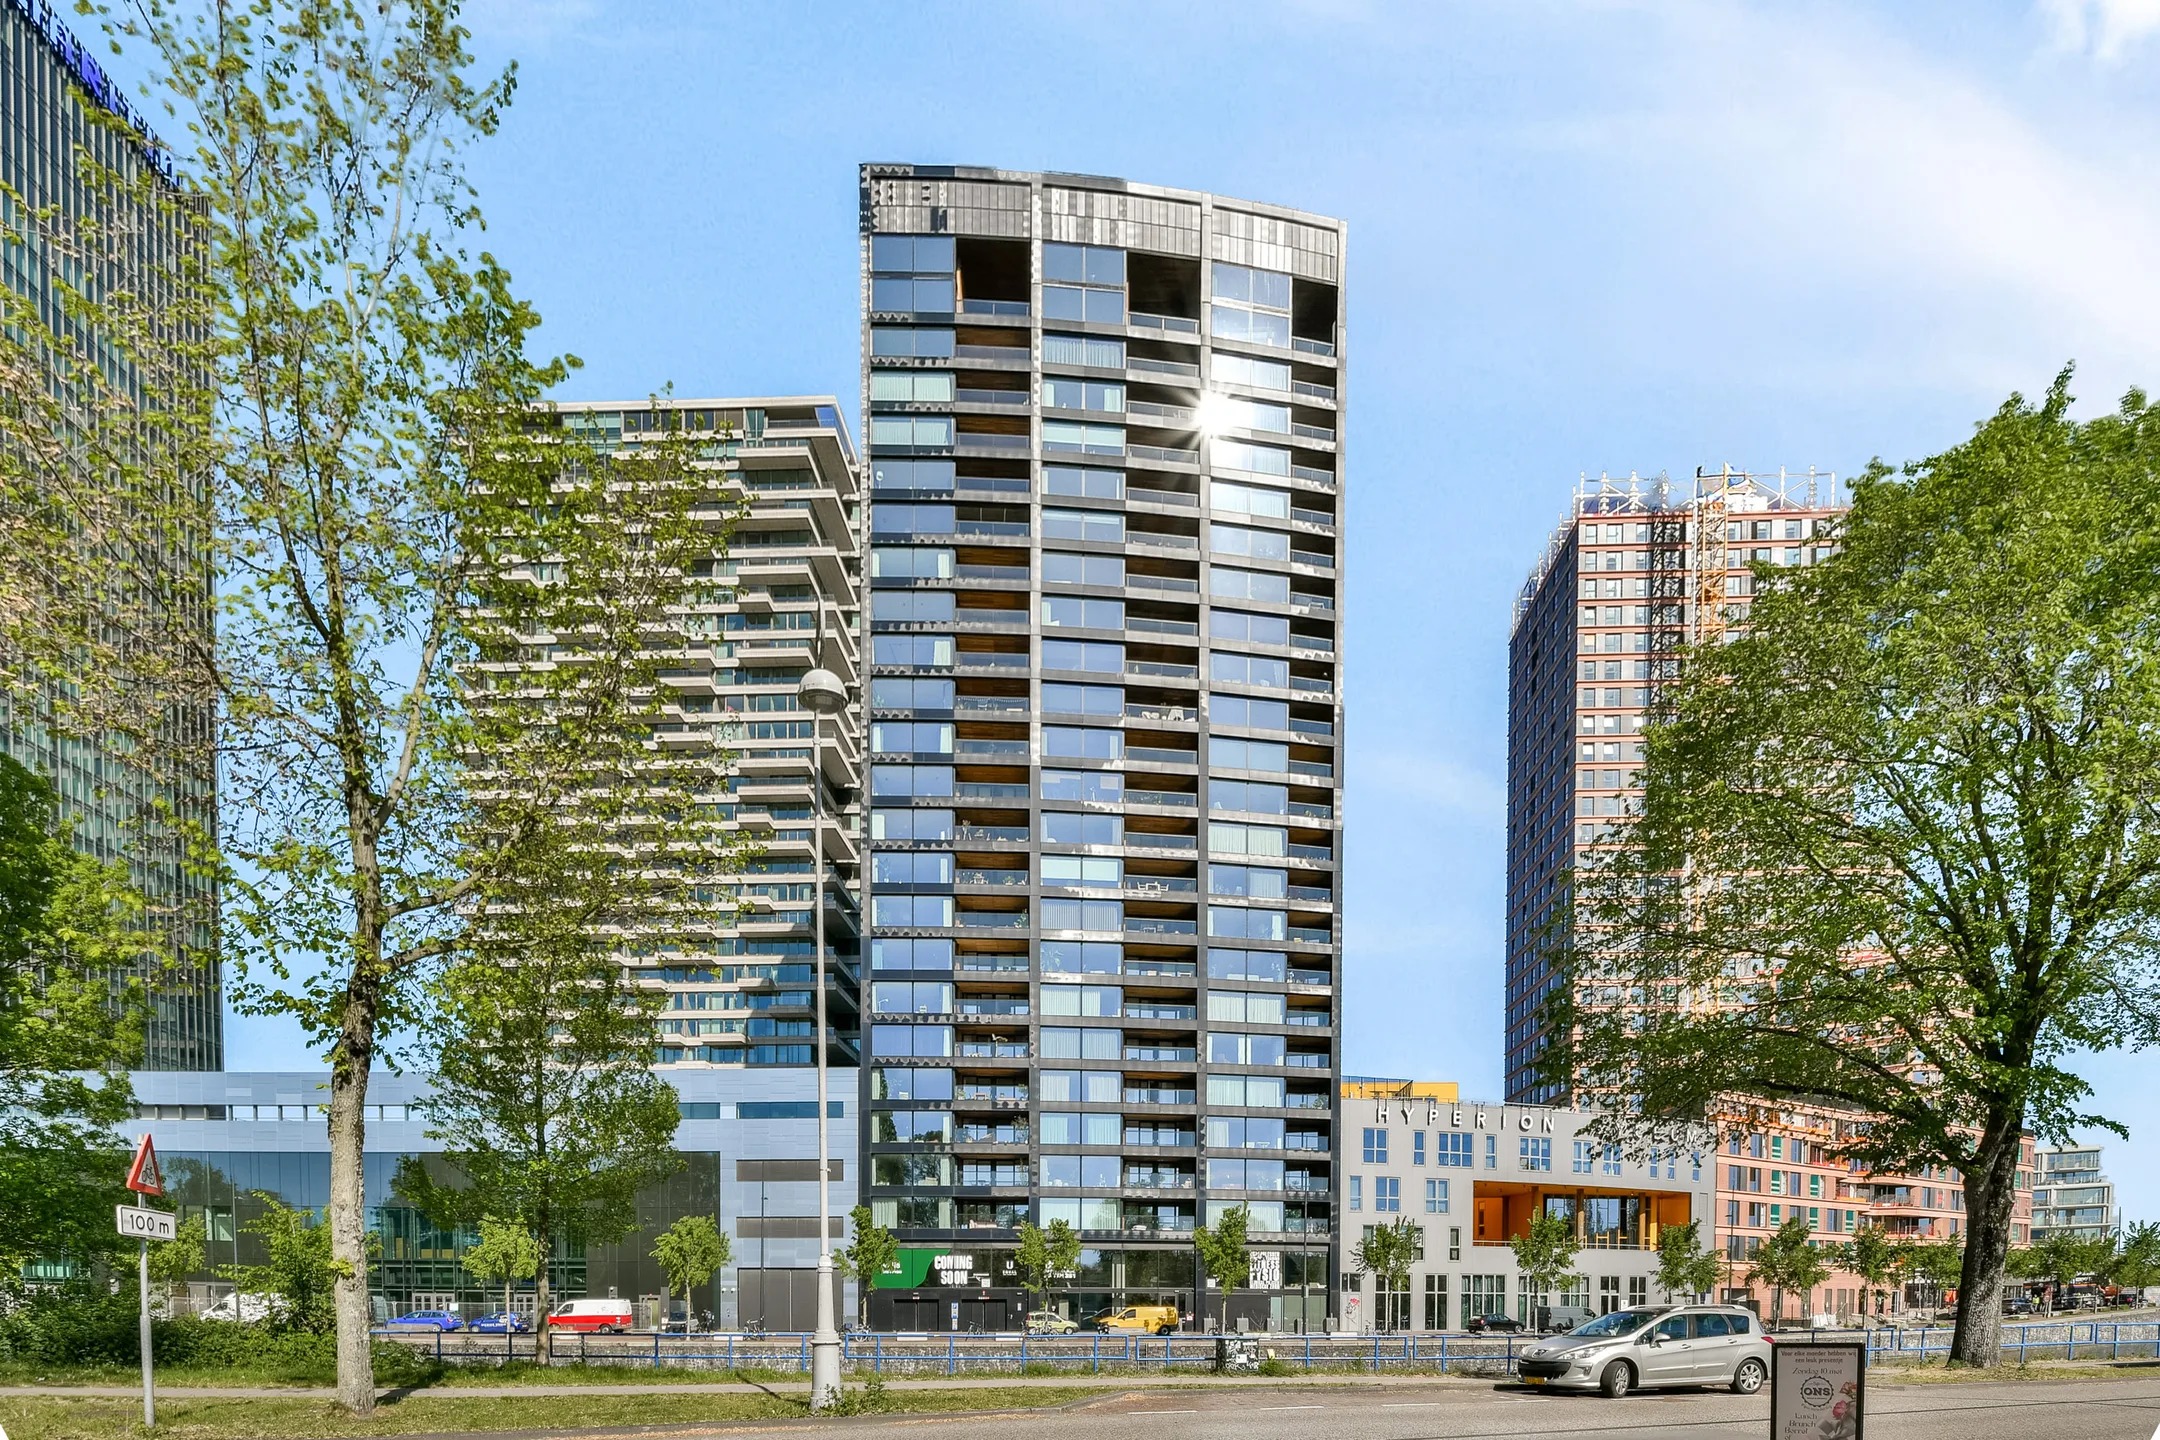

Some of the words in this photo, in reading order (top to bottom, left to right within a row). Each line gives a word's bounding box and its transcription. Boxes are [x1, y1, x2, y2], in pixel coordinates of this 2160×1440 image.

[1377, 1106, 1555, 1131] HYPERION
[130, 1214, 154, 1231] 100
[159, 1222, 170, 1234] m
[934, 1255, 973, 1270] COMING
[940, 1270, 968, 1285] SOON
[1250, 1269, 1280, 1281] FYSIO
[1792, 1367, 1819, 1375] Zondag
[1803, 1387, 1831, 1396] ONS
[1789, 1419, 1816, 1427] Brunch
[1784, 1426, 1808, 1434] Borrel
